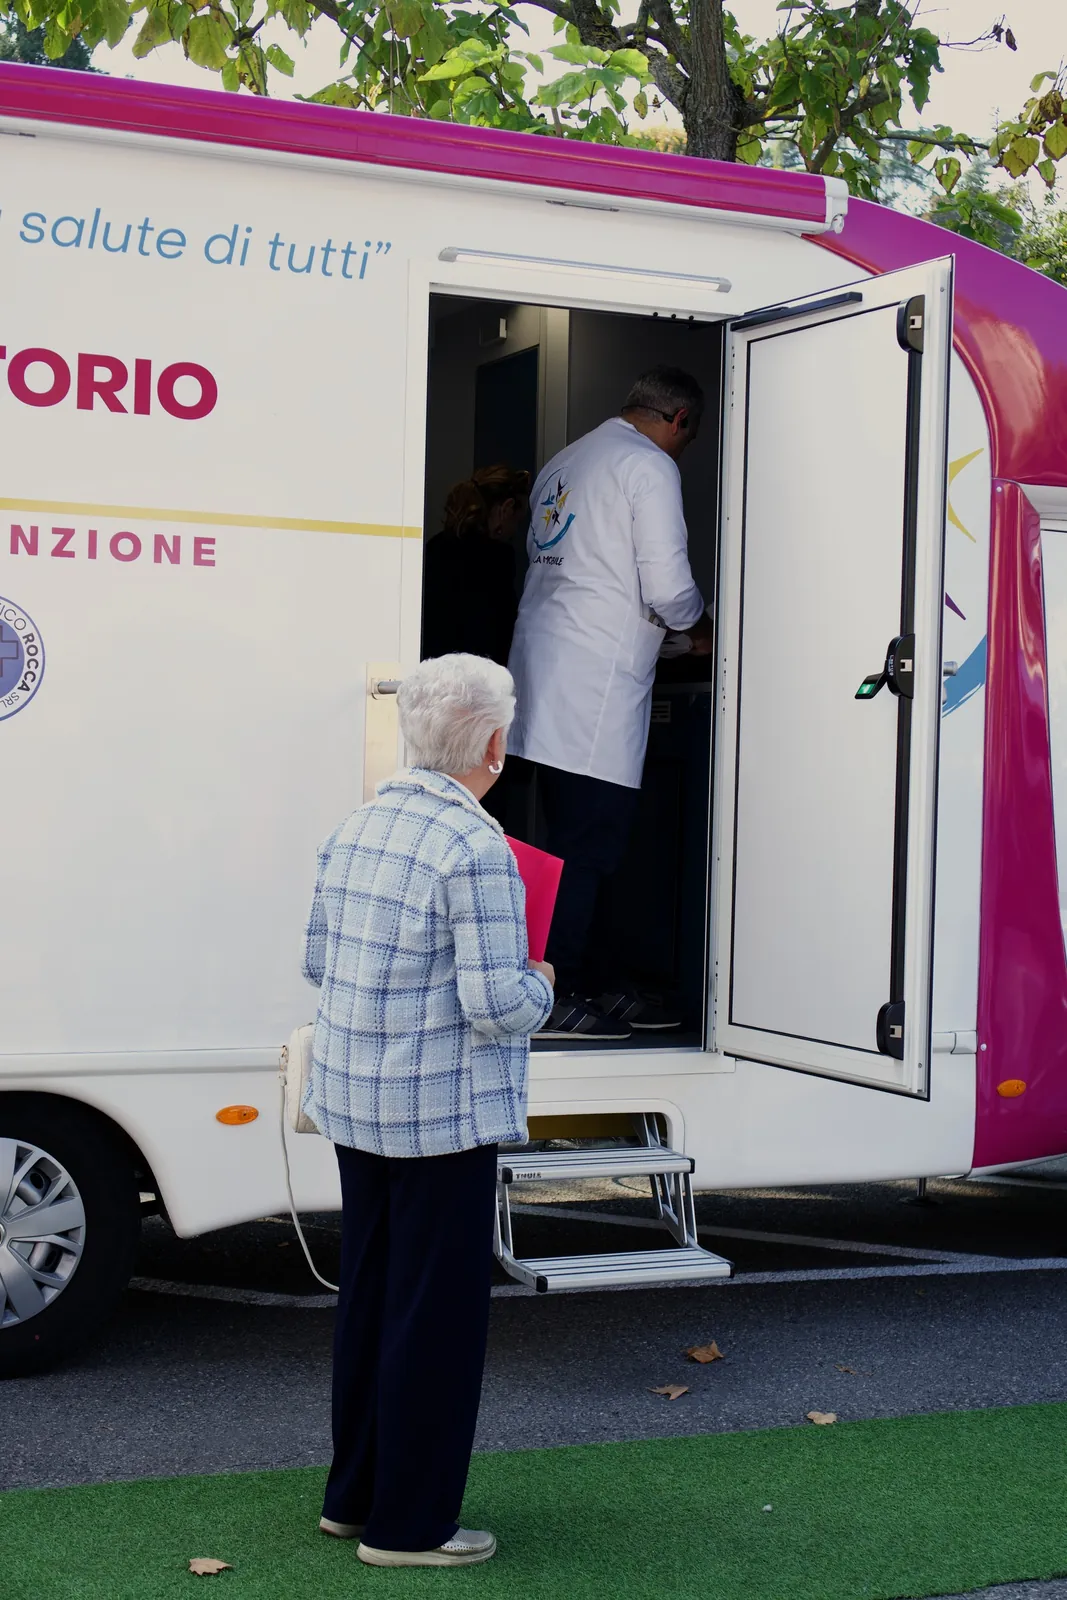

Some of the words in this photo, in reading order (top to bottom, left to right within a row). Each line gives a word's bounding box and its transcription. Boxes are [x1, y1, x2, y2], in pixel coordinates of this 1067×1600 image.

[19, 207, 187, 260] salute
[204, 223, 253, 266] di
[10, 523, 217, 567] NZIONE
[543, 556, 564, 566] MOBILE
[0, 603, 27, 631] ICO
[17, 632, 39, 692] ROCCA
